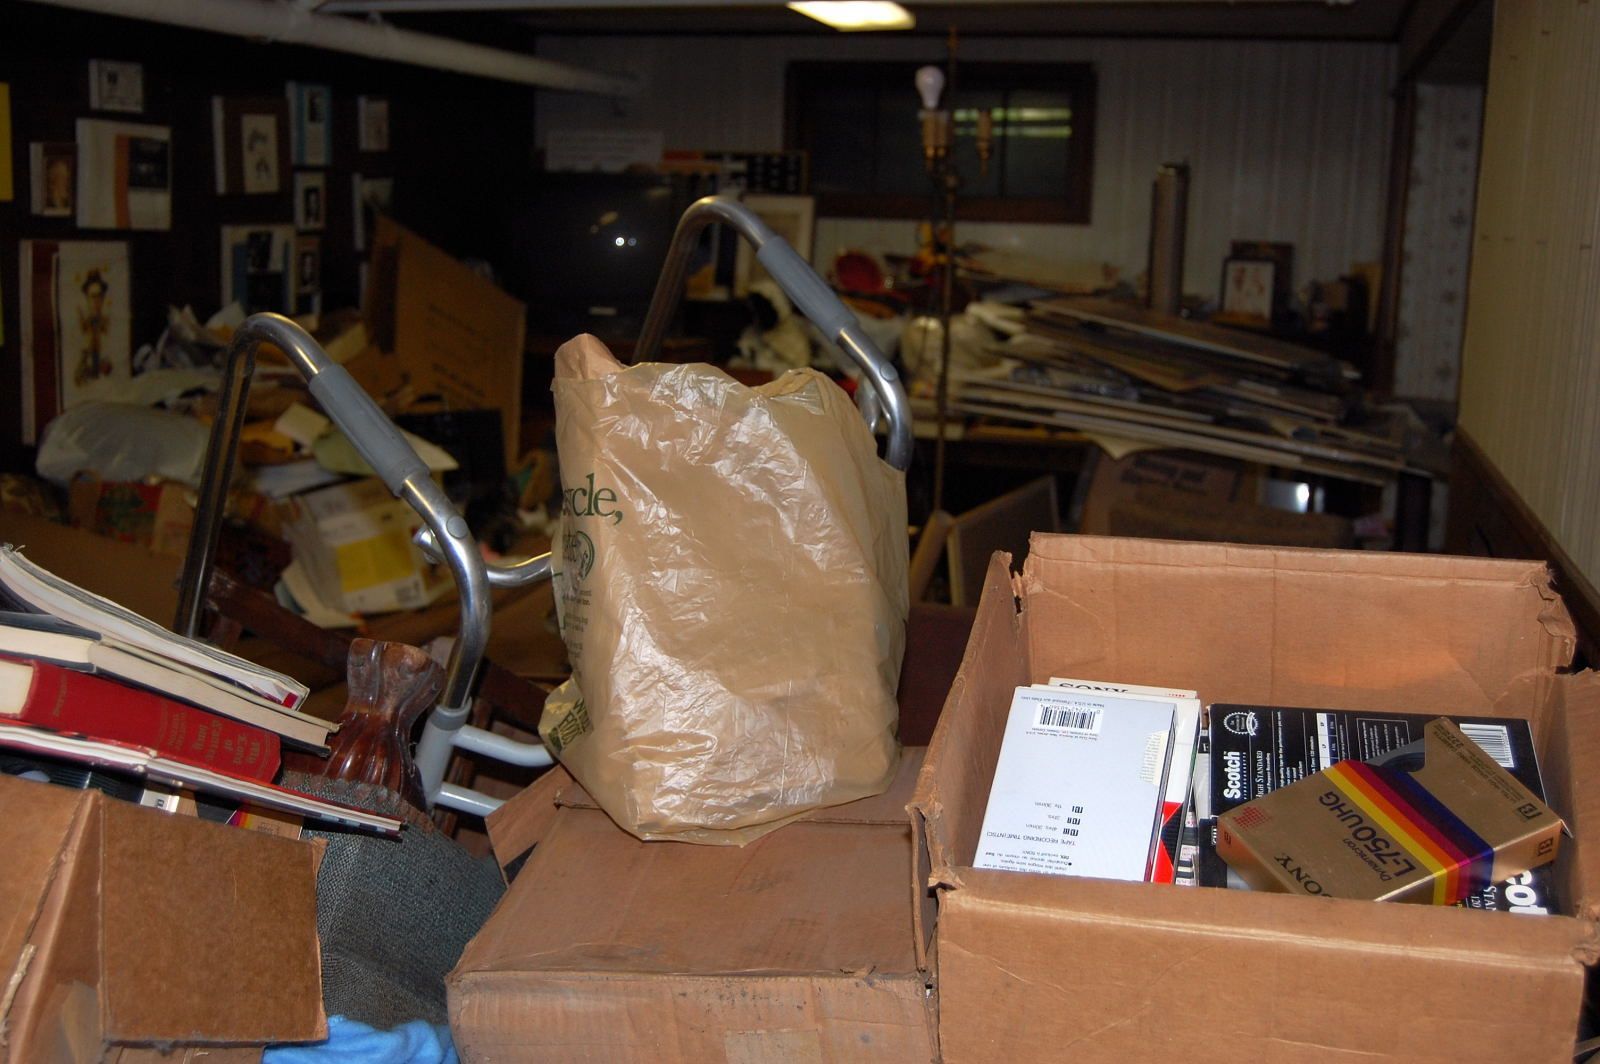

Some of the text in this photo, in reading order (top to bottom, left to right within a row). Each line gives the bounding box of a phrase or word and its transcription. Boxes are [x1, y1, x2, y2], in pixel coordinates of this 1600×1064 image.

[1022, 835, 1058, 845] RECORDING
[1316, 793, 1417, 877] L-750UHG
[1342, 839, 1392, 883] Dynamicron
[1471, 896, 1481, 907] 120
[1505, 870, 1547, 915] cot
